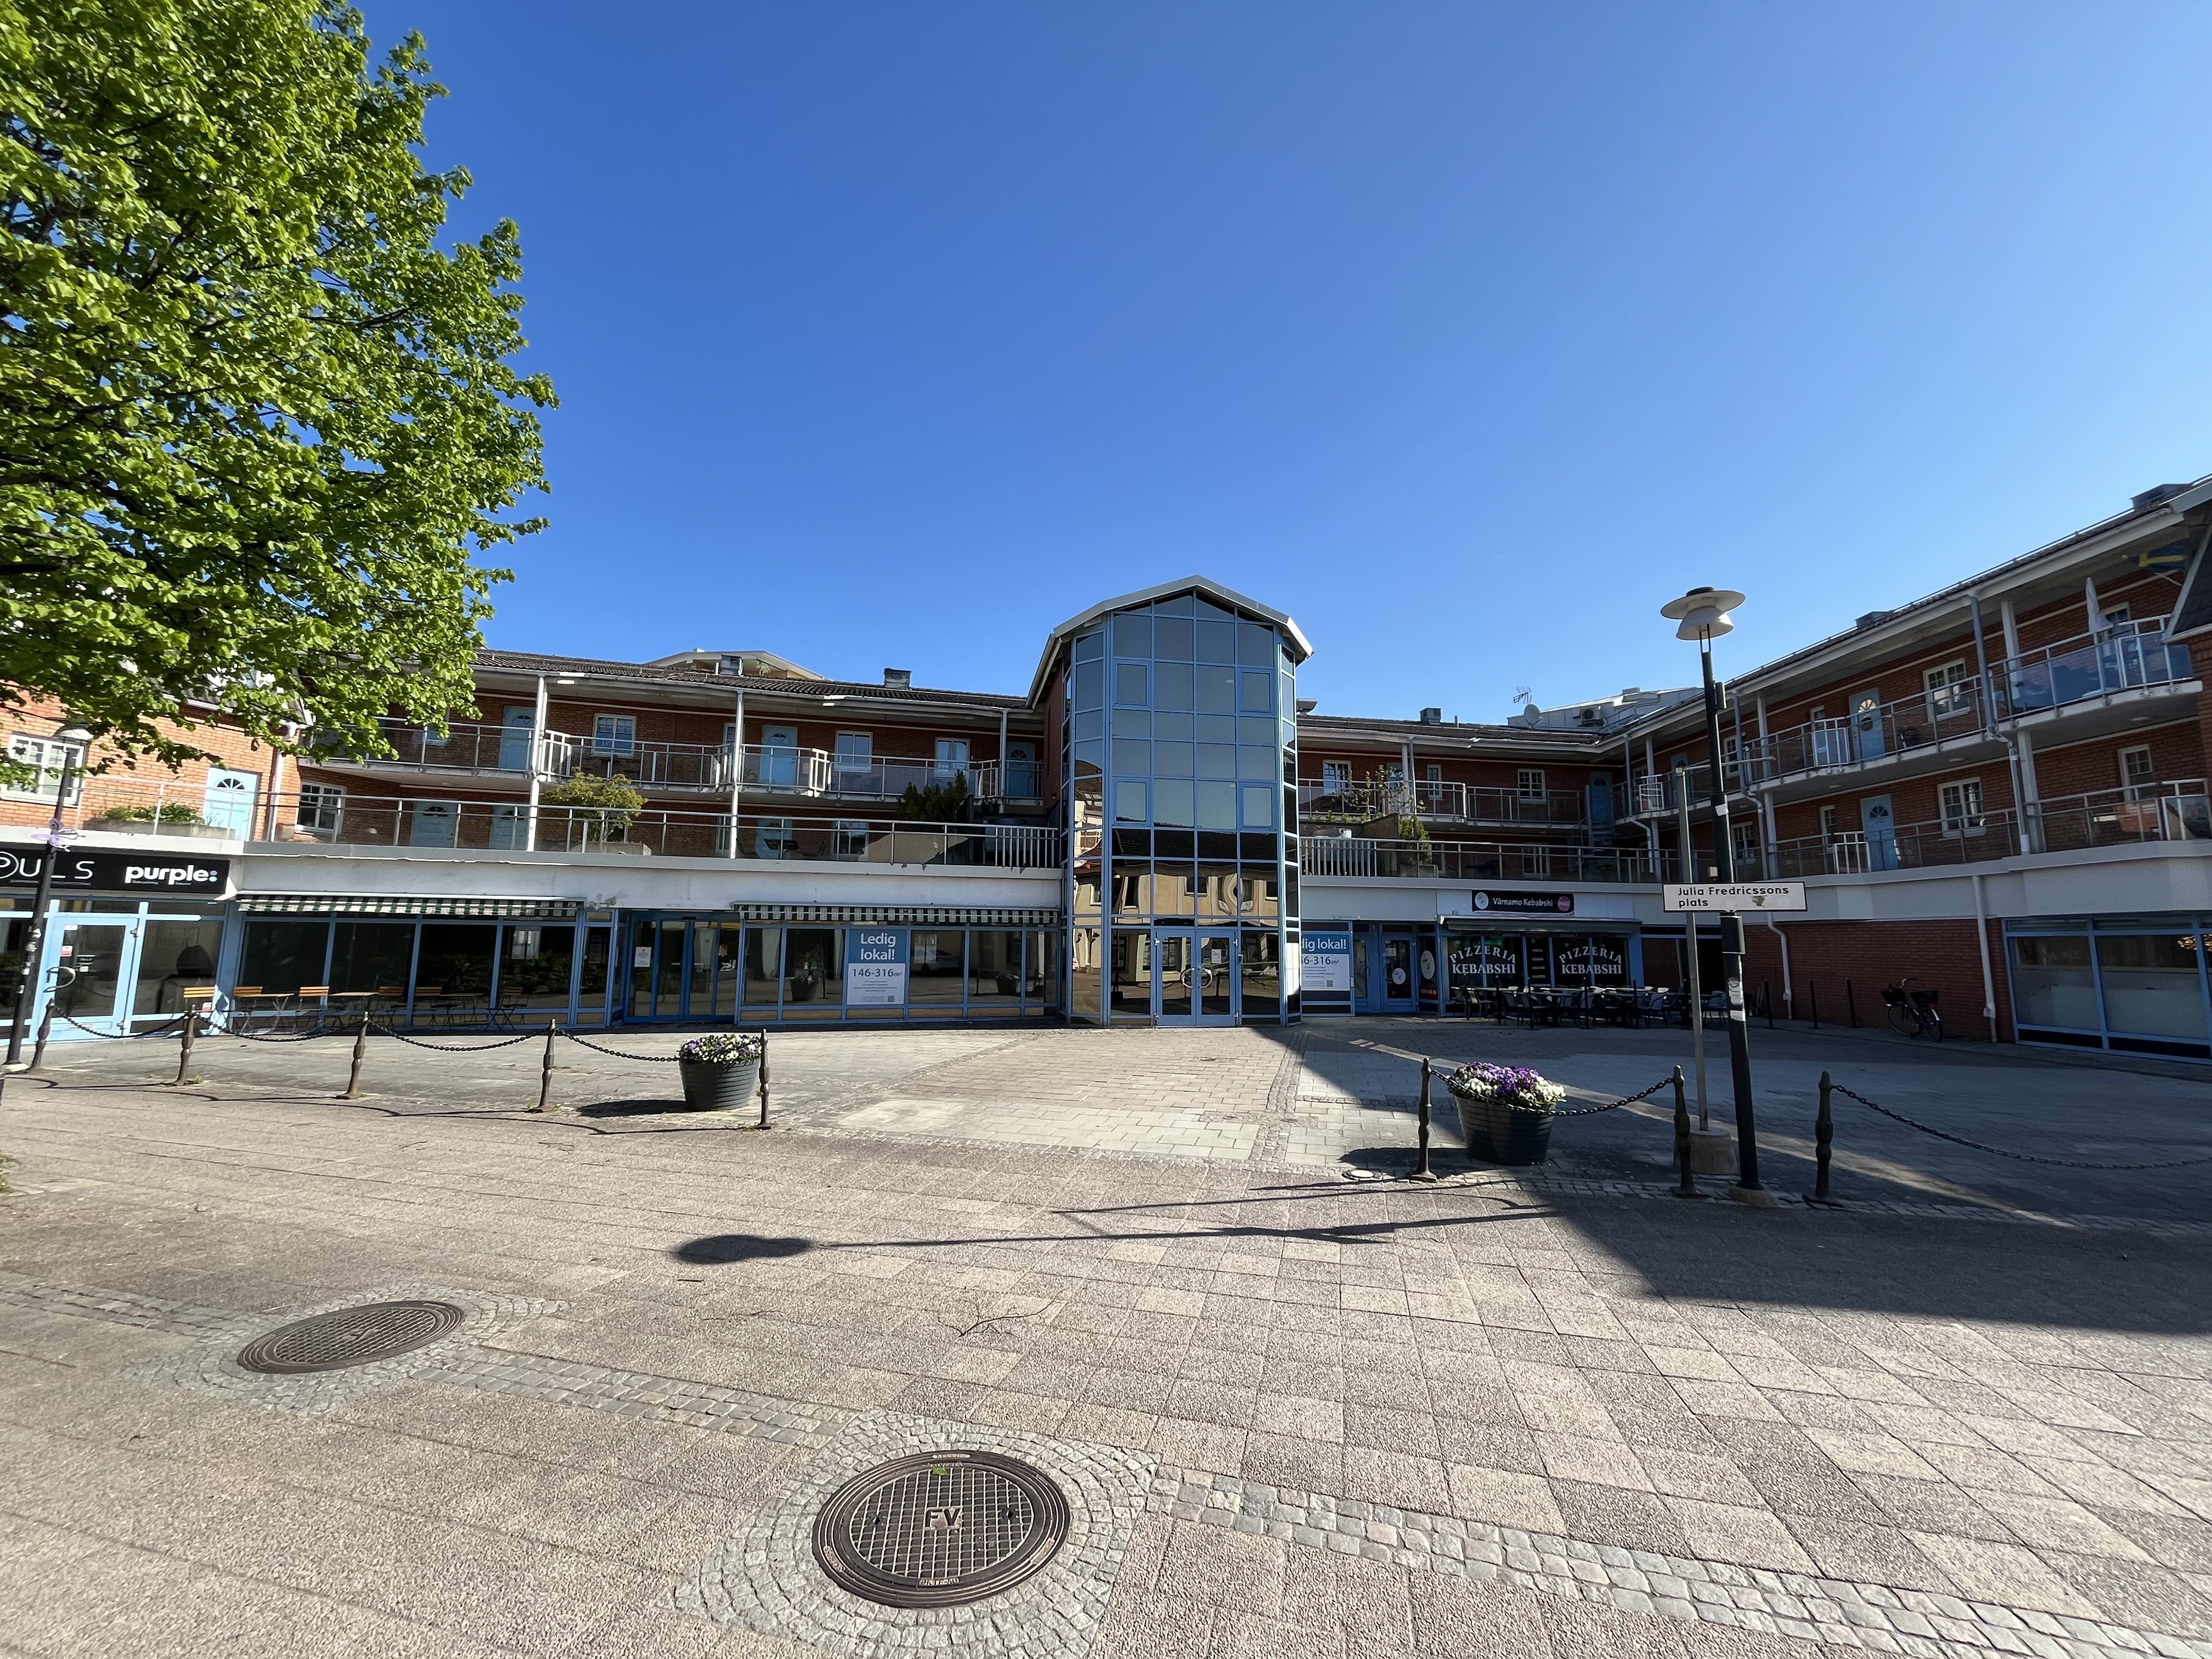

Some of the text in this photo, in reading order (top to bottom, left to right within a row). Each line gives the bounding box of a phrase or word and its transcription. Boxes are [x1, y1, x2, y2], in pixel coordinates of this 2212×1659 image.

[1678, 885, 1789, 895] Julia Fredricssons
[1523, 898, 1553, 906] Kebabshi
[1679, 898, 1708, 909] plats
[860, 933, 896, 947] Ledig
[1317, 938, 1346, 950] lokal!
[860, 948, 895, 960] lokal!
[1449, 945, 1516, 964] PIZZERIA
[1559, 946, 1622, 964] PIZZERIA
[1452, 963, 1516, 974] KEBABSHI
[1561, 964, 1622, 974] KEBABSHI
[925, 1508, 961, 1527] FV
